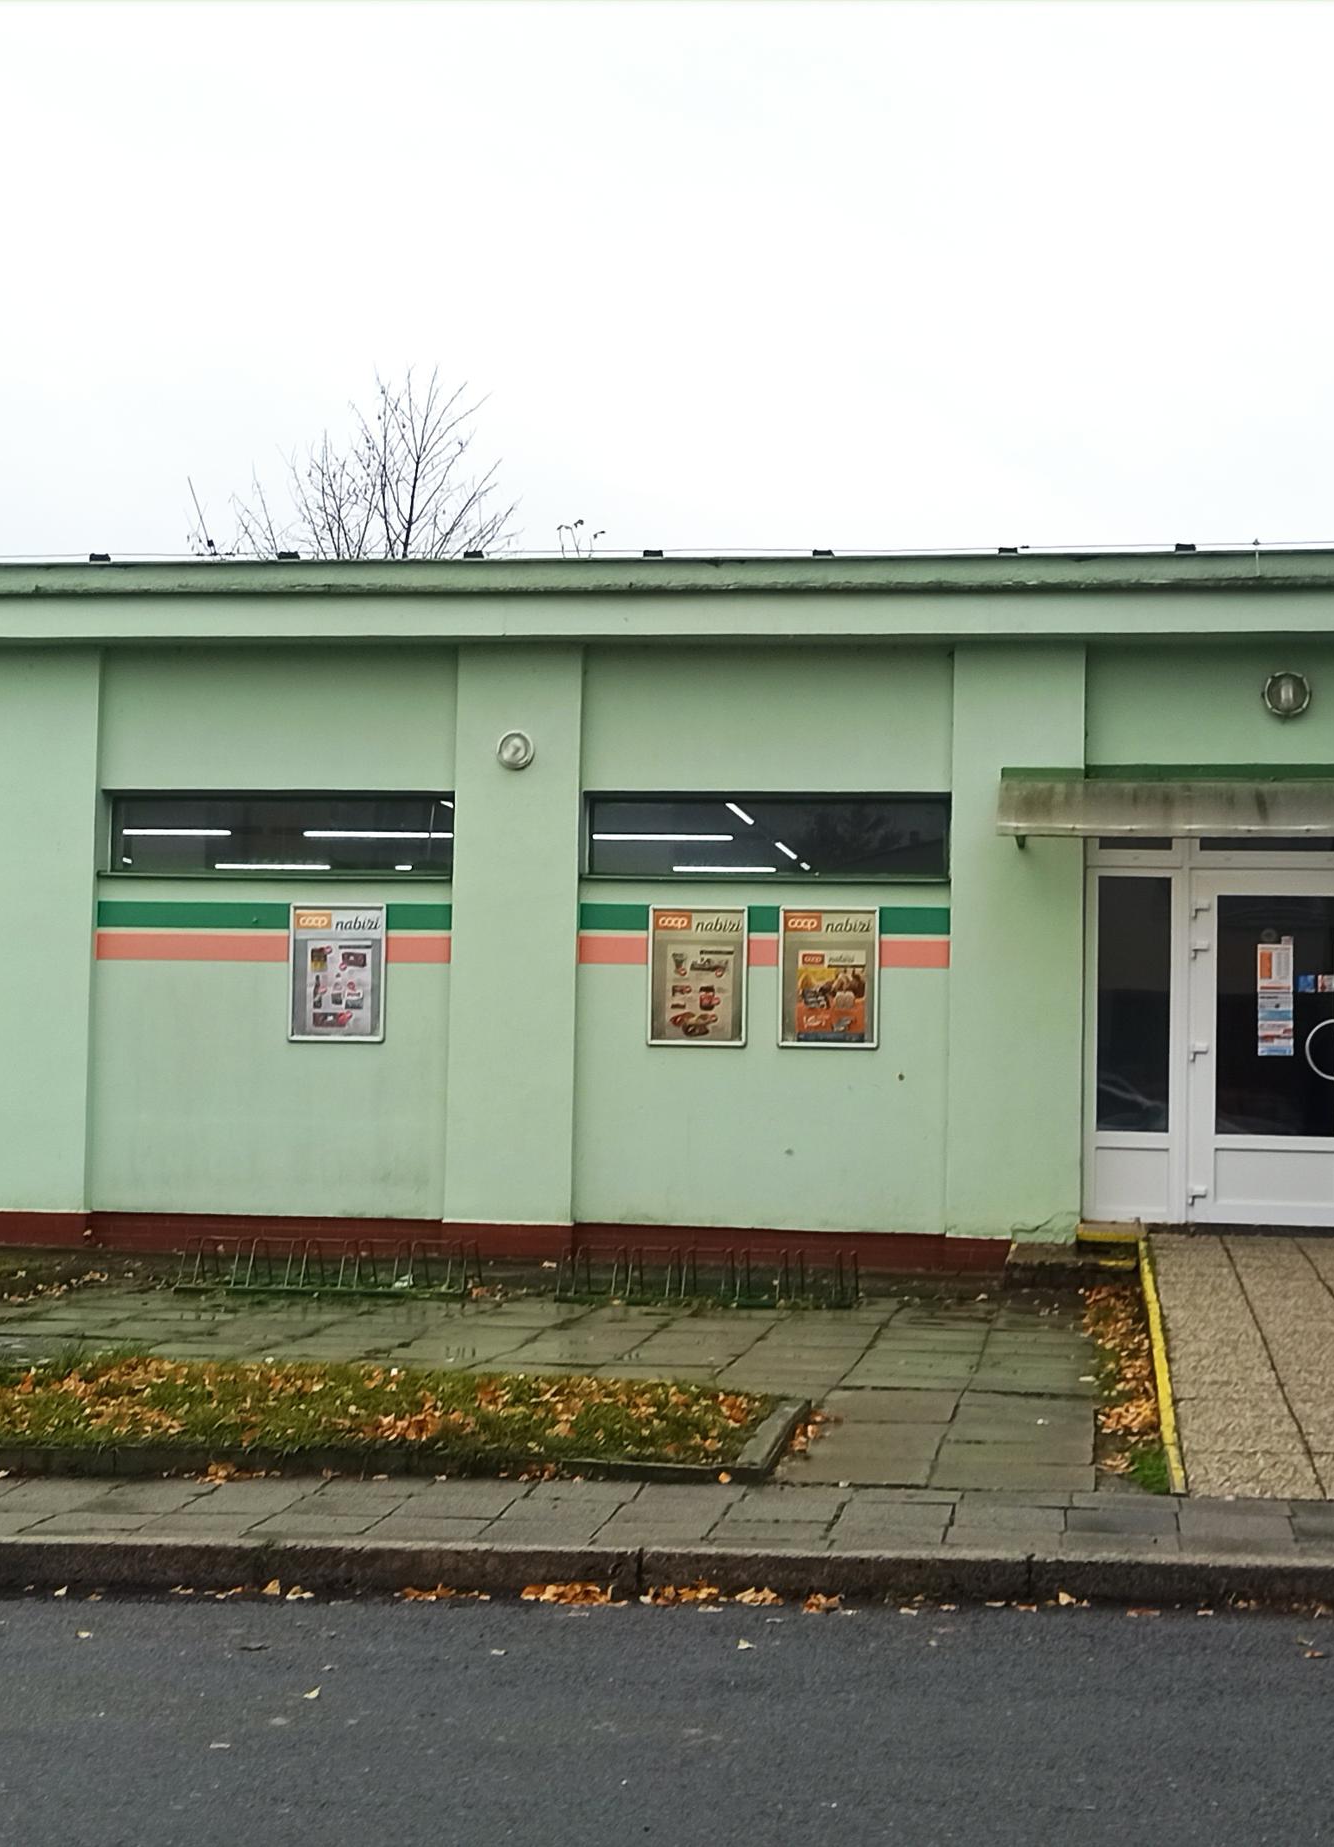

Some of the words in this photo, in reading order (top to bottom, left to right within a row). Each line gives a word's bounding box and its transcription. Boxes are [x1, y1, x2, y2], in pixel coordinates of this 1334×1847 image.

[299, 916, 328, 928] coop
[658, 916, 688, 929] coop
[787, 918, 818, 931] coop
